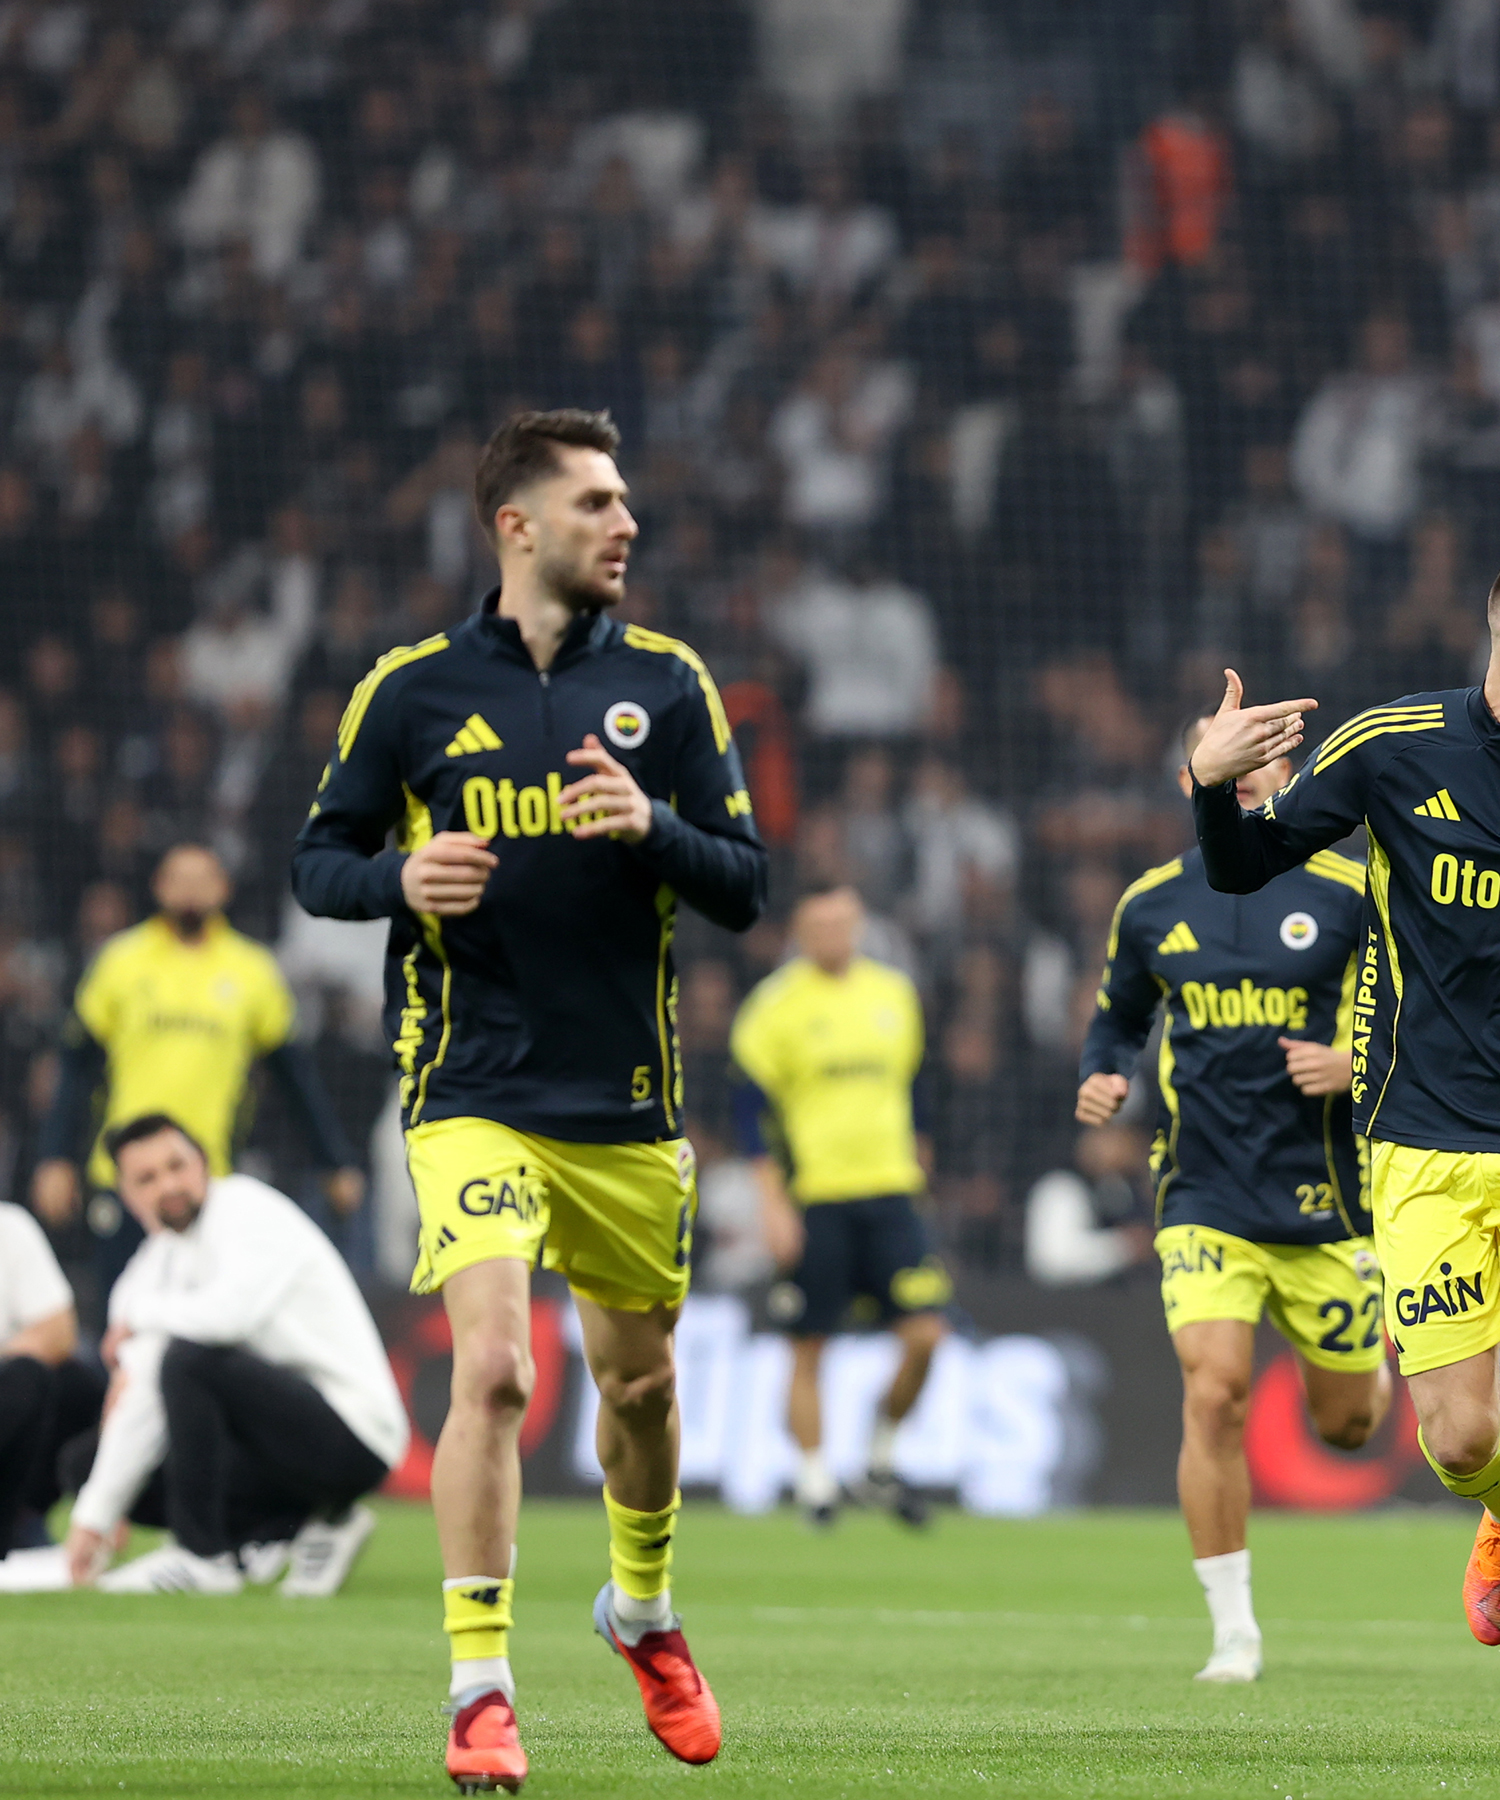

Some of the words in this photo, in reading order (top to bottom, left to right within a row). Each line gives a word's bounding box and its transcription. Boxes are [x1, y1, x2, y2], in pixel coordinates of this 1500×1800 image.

[462, 772, 622, 842] Otok
[1181, 978, 1309, 1030] Otokoç
[1352, 925, 1379, 1075] SAFİPORT
[631, 1065, 652, 1101] 5
[1295, 1182, 1334, 1215] 22
[1318, 1292, 1381, 1353] 22
